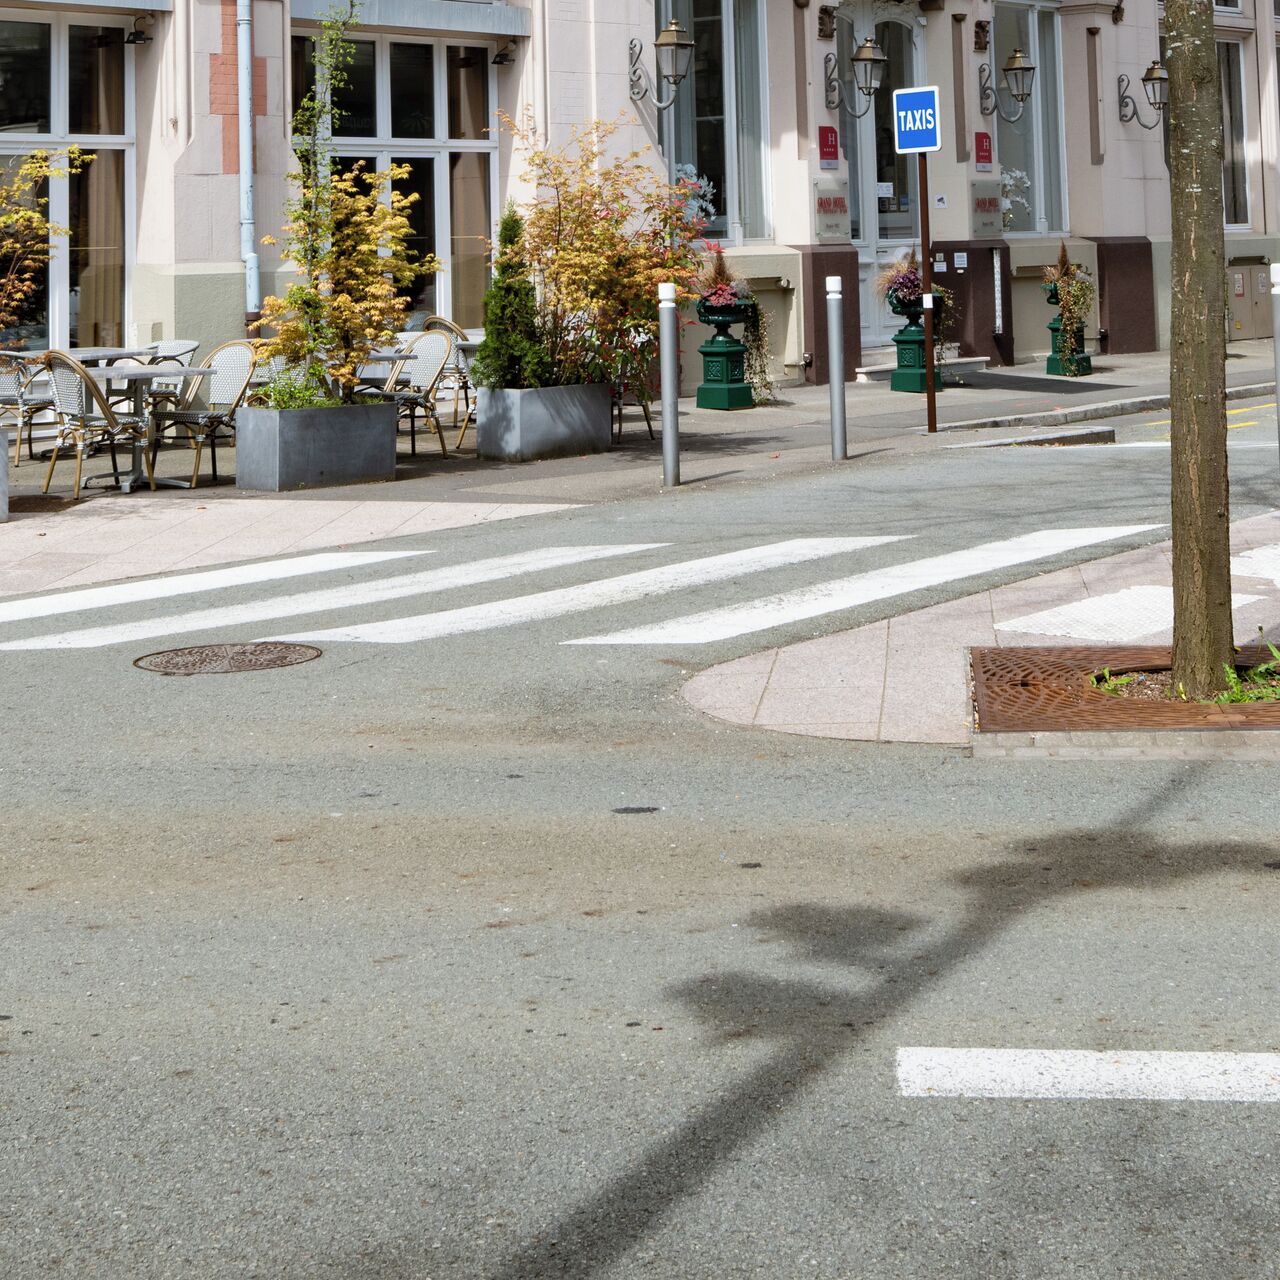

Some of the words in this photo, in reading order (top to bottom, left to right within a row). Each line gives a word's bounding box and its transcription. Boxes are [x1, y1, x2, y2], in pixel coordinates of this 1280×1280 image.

[898, 108, 935, 131] TAXIS
[828, 133, 836, 144] H
[983, 139, 990, 149] H
